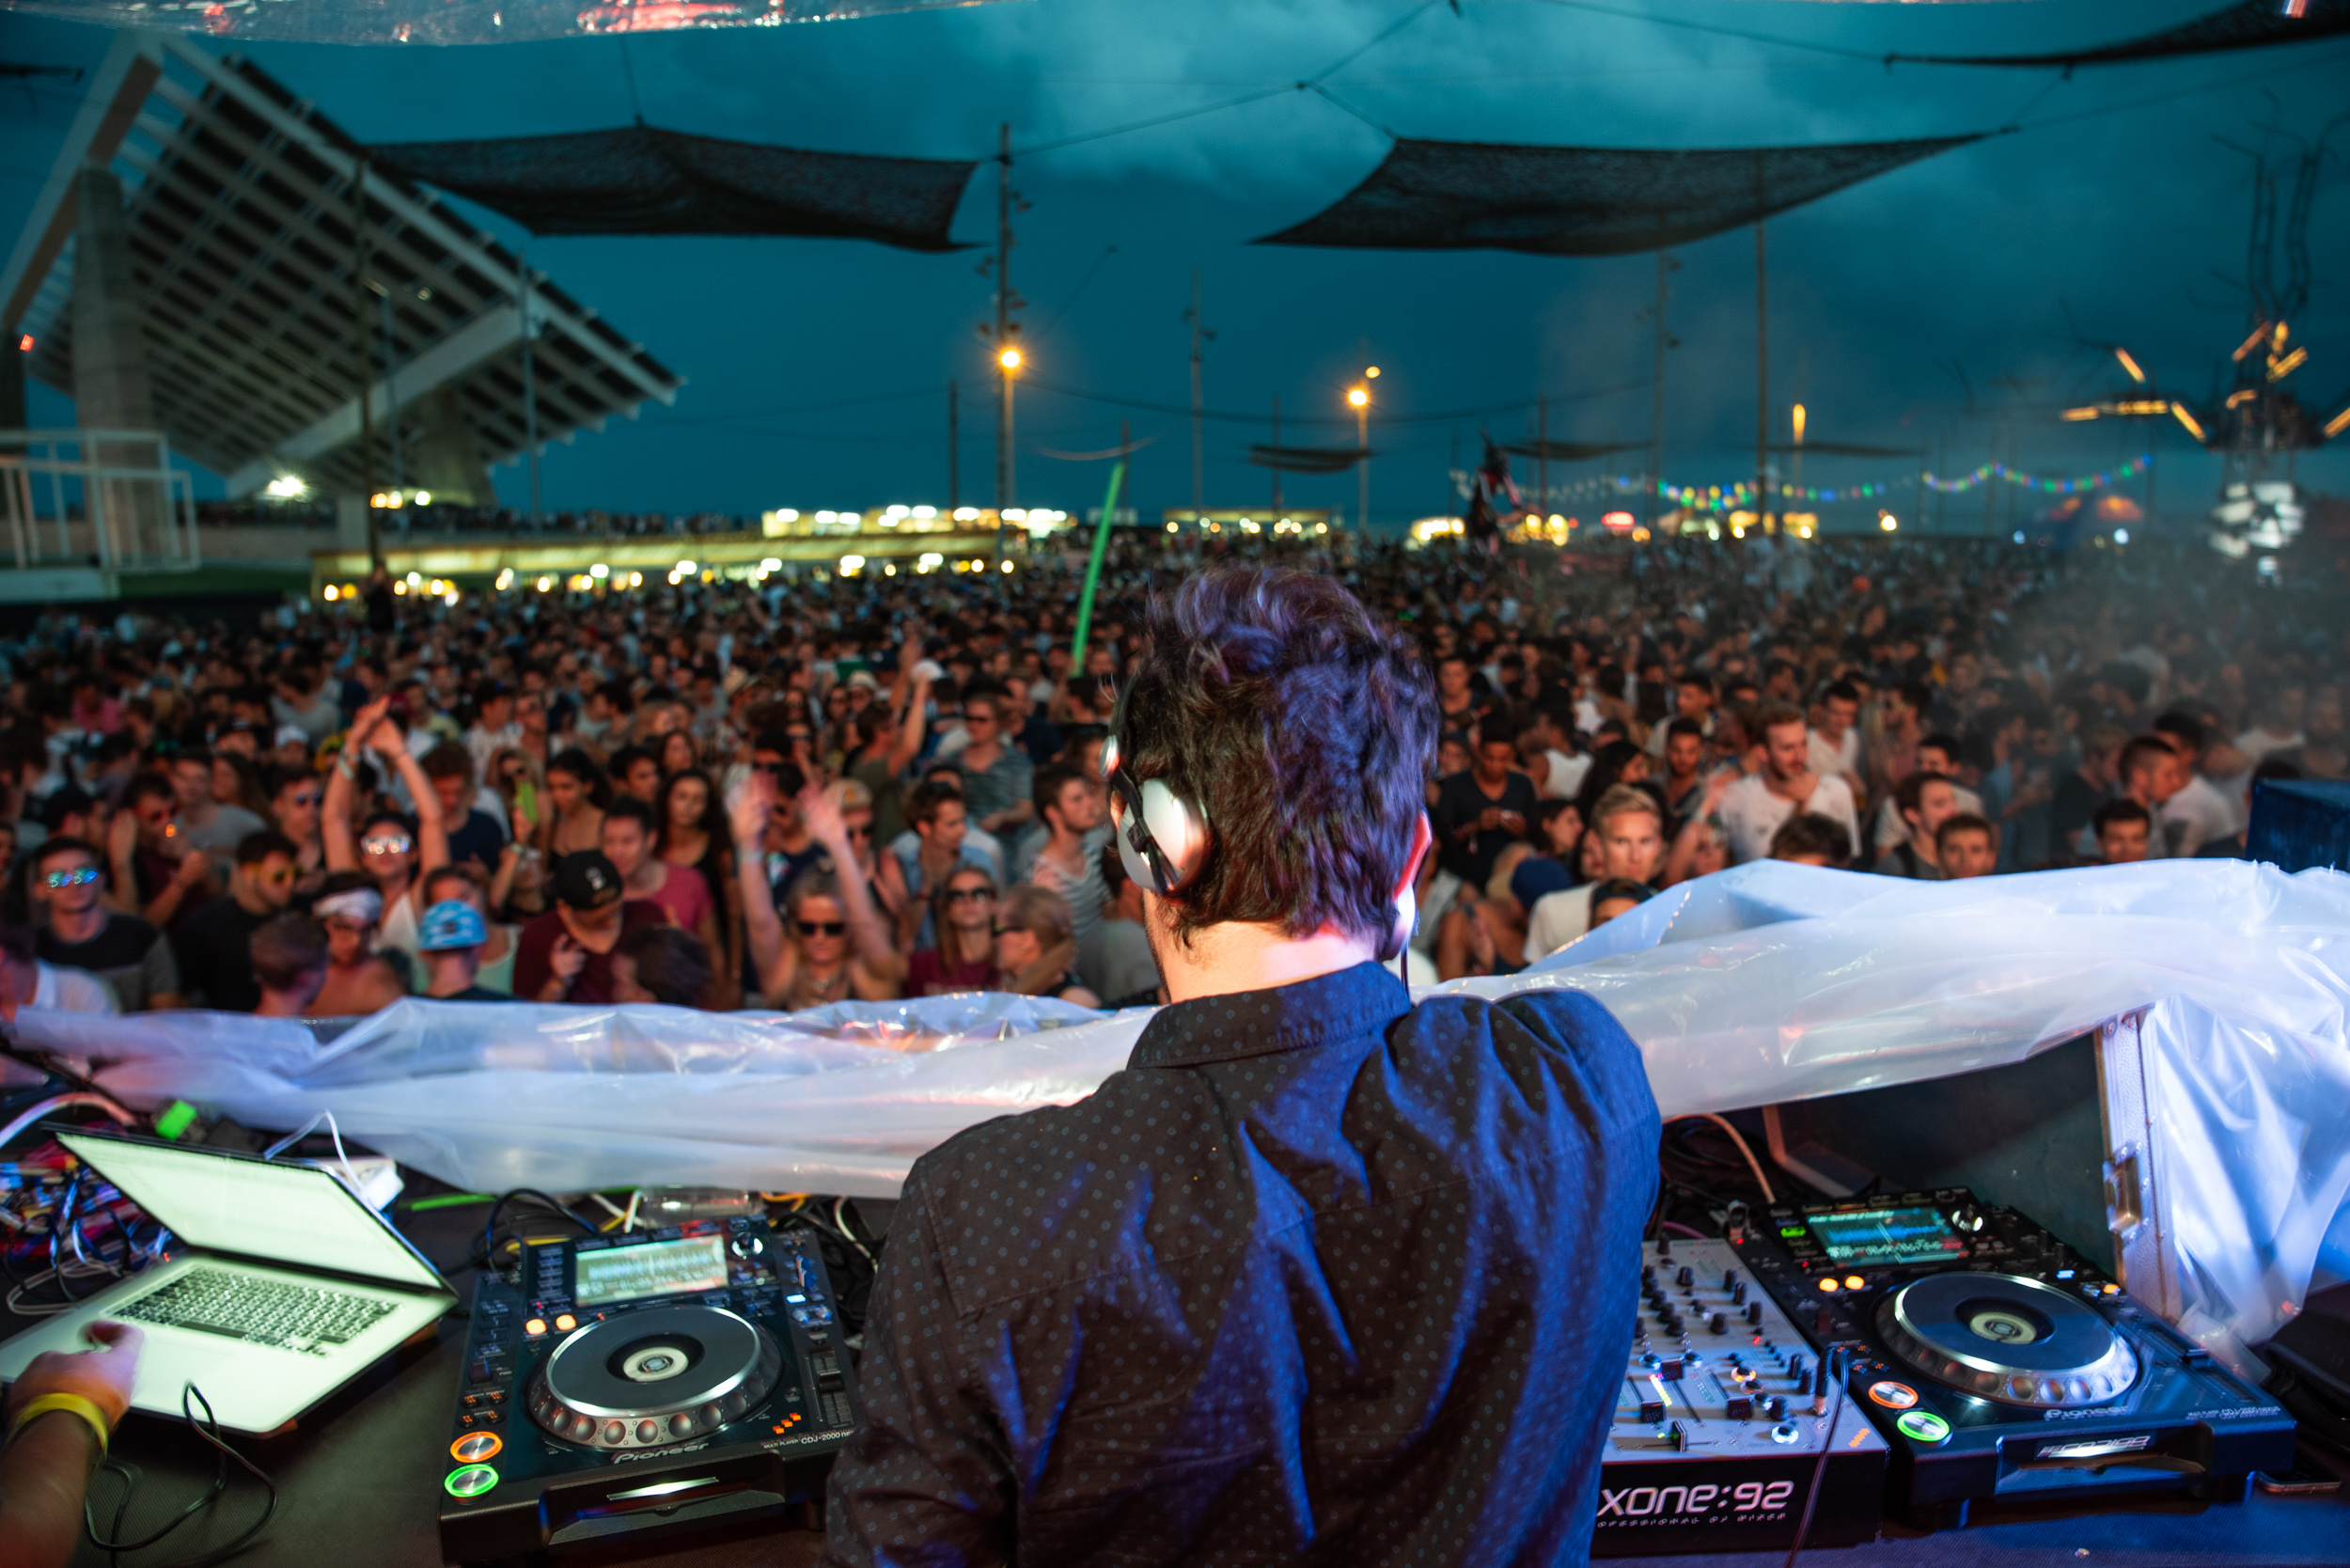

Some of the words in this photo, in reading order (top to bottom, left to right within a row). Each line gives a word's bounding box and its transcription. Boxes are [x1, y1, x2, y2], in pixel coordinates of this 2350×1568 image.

[2044, 1405, 2128, 1421] Pioneer
[613, 1442, 709, 1465] Pioneer
[1709, 1514, 1729, 1523] DJ
[1736, 1513, 1786, 1523] MIXER
